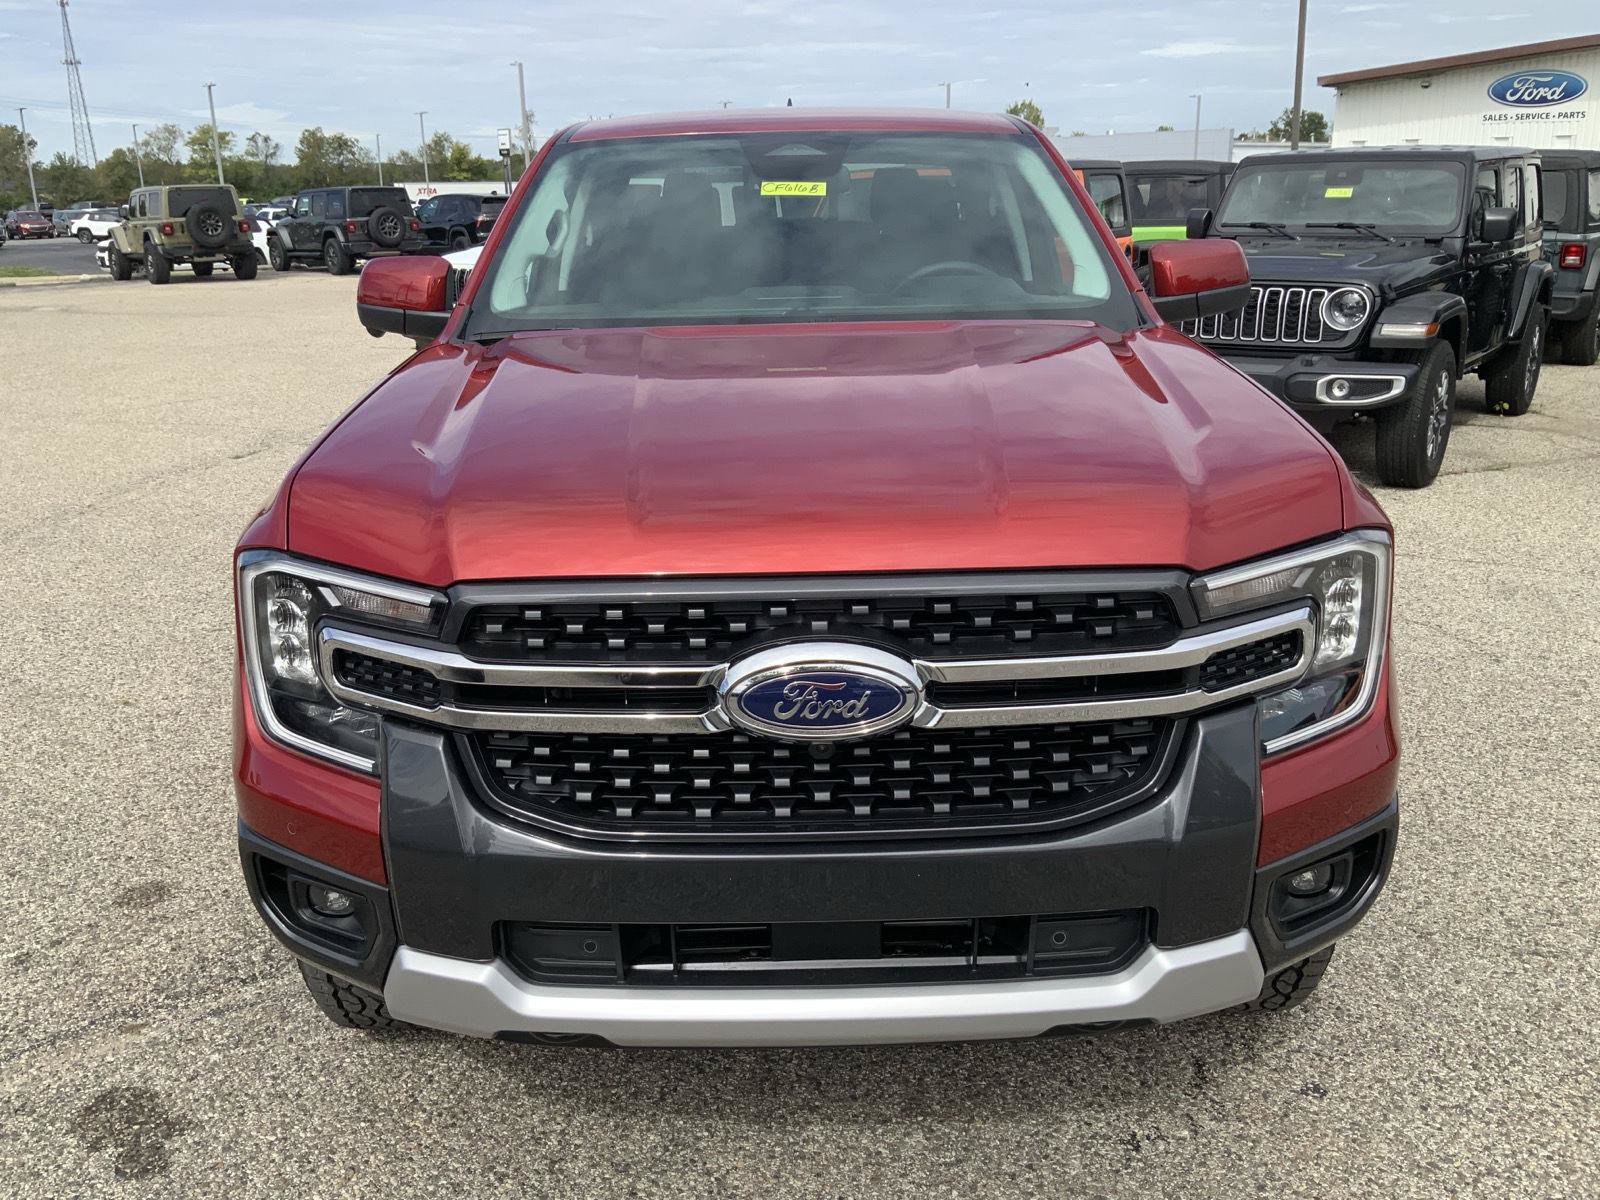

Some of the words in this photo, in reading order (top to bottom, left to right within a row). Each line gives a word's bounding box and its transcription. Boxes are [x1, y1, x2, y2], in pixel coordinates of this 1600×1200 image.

[1506, 76, 1568, 101] Ford
[1482, 114, 1508, 122] SALES
[1514, 112, 1551, 121] SERVICE
[1557, 111, 1586, 119] PARTS
[773, 680, 872, 720] Ford
